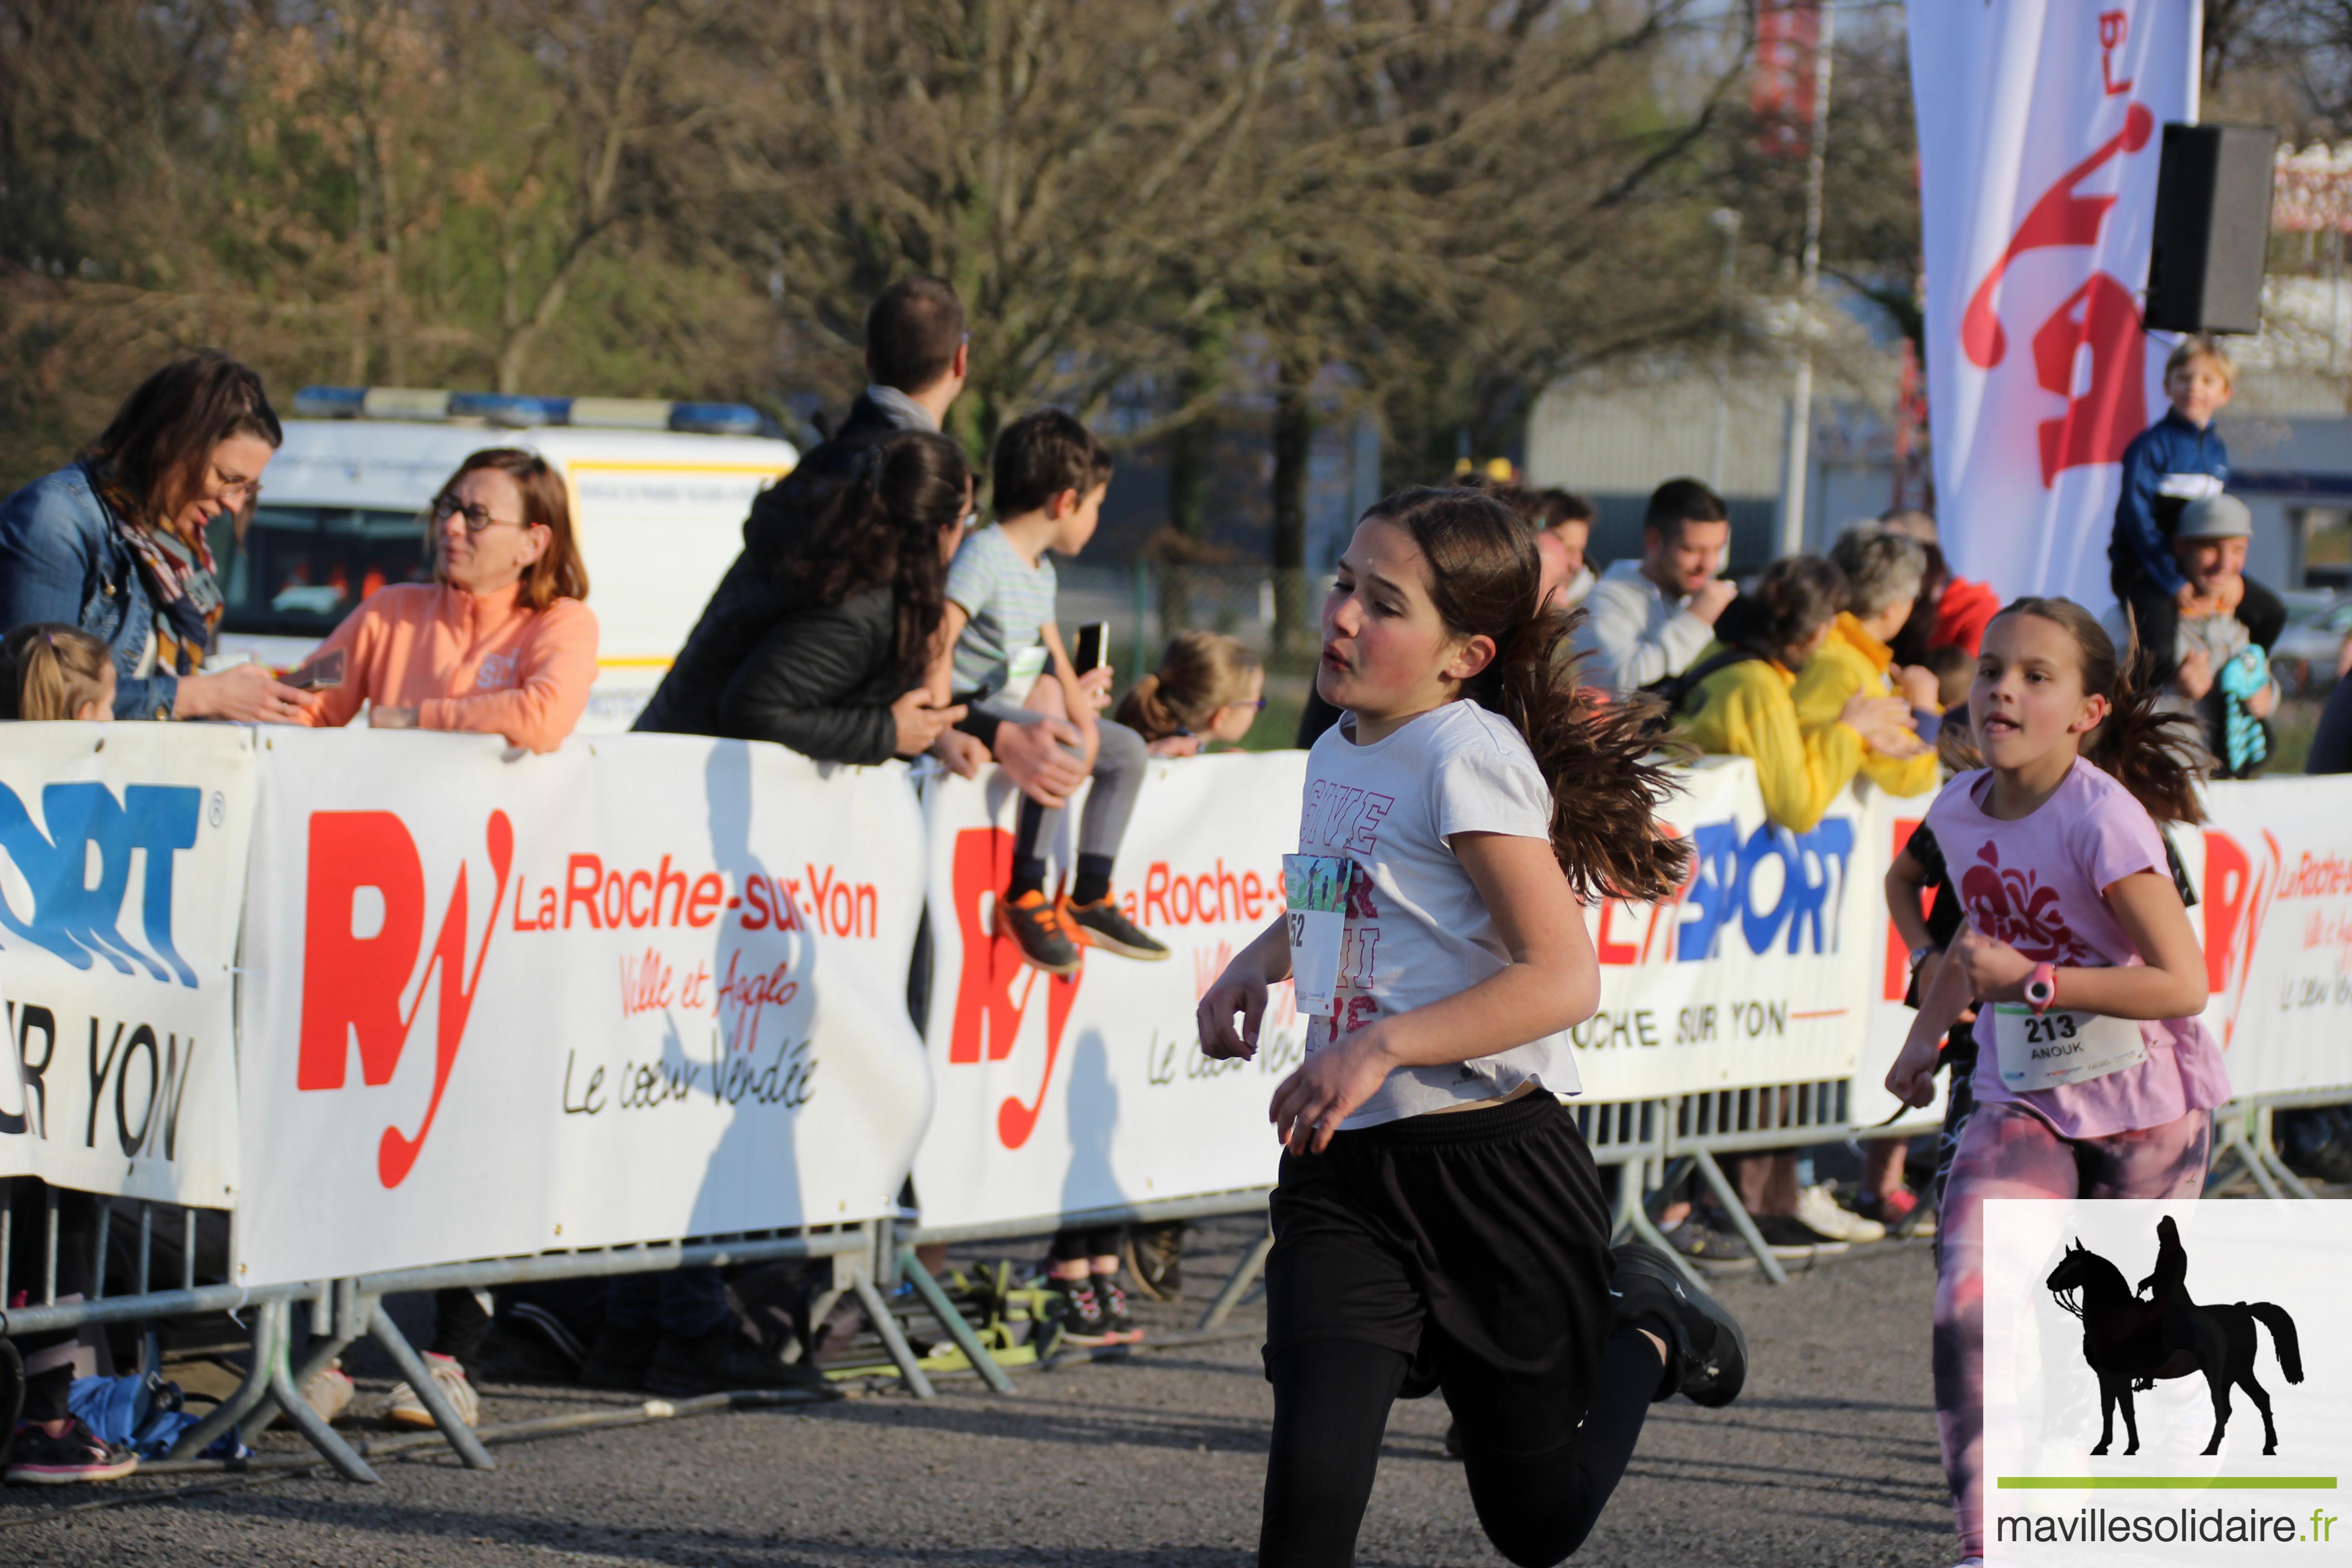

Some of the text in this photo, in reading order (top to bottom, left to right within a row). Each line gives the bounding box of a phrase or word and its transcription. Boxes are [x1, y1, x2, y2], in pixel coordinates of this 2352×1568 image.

[1300, 779, 1395, 856] GIVE
[0, 779, 201, 989] ORT
[513, 853, 878, 939] La Roche-sur-Yon
[1287, 912, 1305, 947] 52
[620, 946, 799, 1054] Ville et Agglo
[1573, 1000, 1787, 1049] OCHE SUR YON
[2025, 1014, 2077, 1043] 213
[85, 1014, 195, 1161] YON
[564, 1047, 607, 1114] Le
[711, 1026, 818, 1109] Vendée
[2032, 1041, 2084, 1060] ANOUK
